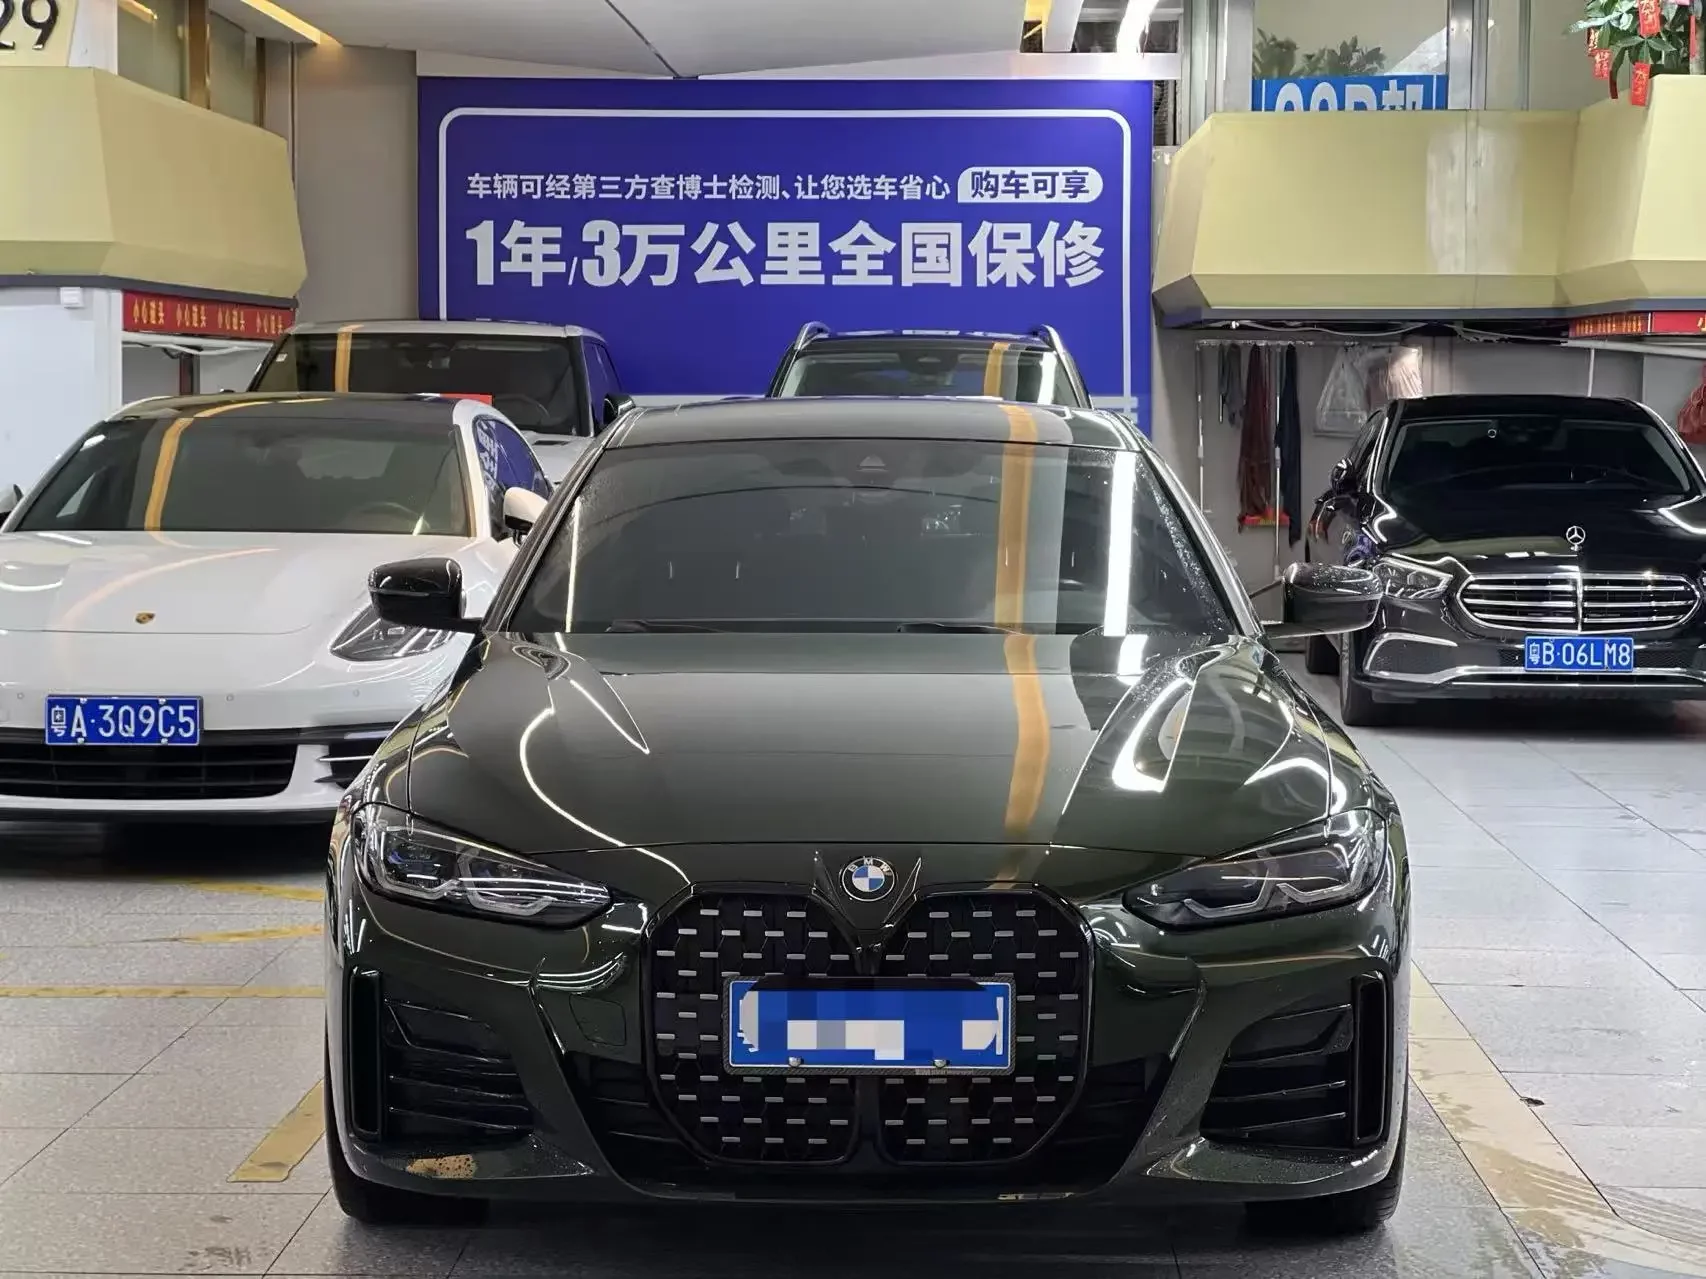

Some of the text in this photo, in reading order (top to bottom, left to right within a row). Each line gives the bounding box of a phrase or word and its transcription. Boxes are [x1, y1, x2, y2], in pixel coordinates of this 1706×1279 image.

[466, 170, 1090, 200] 车辆可经第三方查博士检测、让您选车省心 购车可享
[465, 219, 1105, 287] 1年/3万公里全国保修
